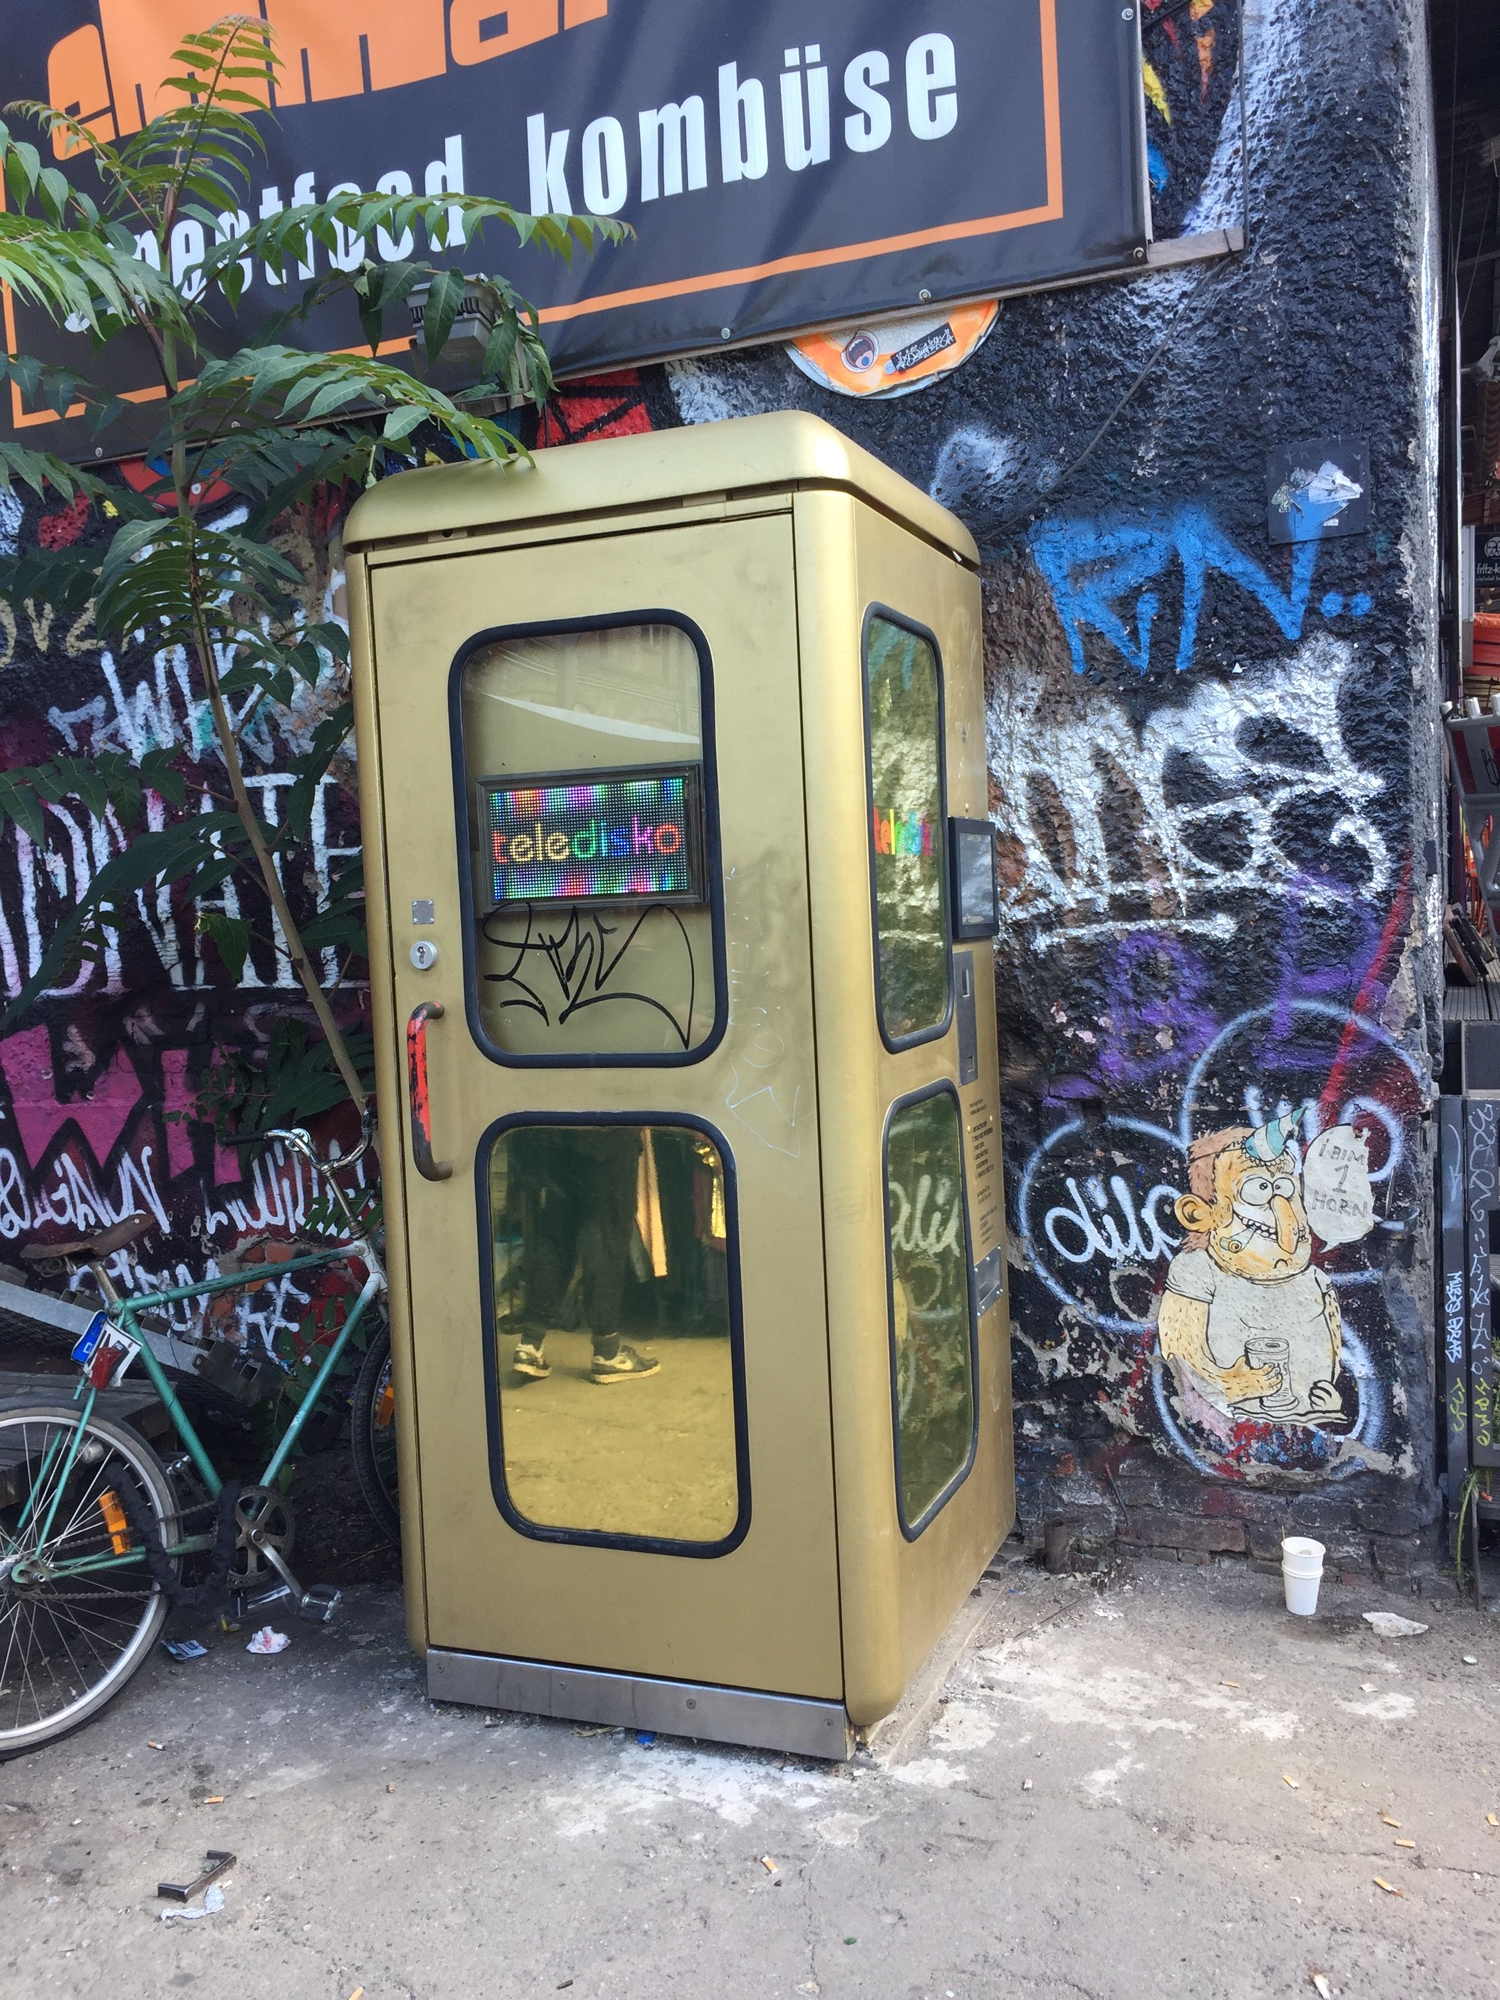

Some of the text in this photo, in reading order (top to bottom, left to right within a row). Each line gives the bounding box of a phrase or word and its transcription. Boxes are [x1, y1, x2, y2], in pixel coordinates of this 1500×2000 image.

[527, 32, 959, 218] kombüse
[491, 814, 683, 864] teledisko
[1311, 1188, 1369, 1218] HORN
